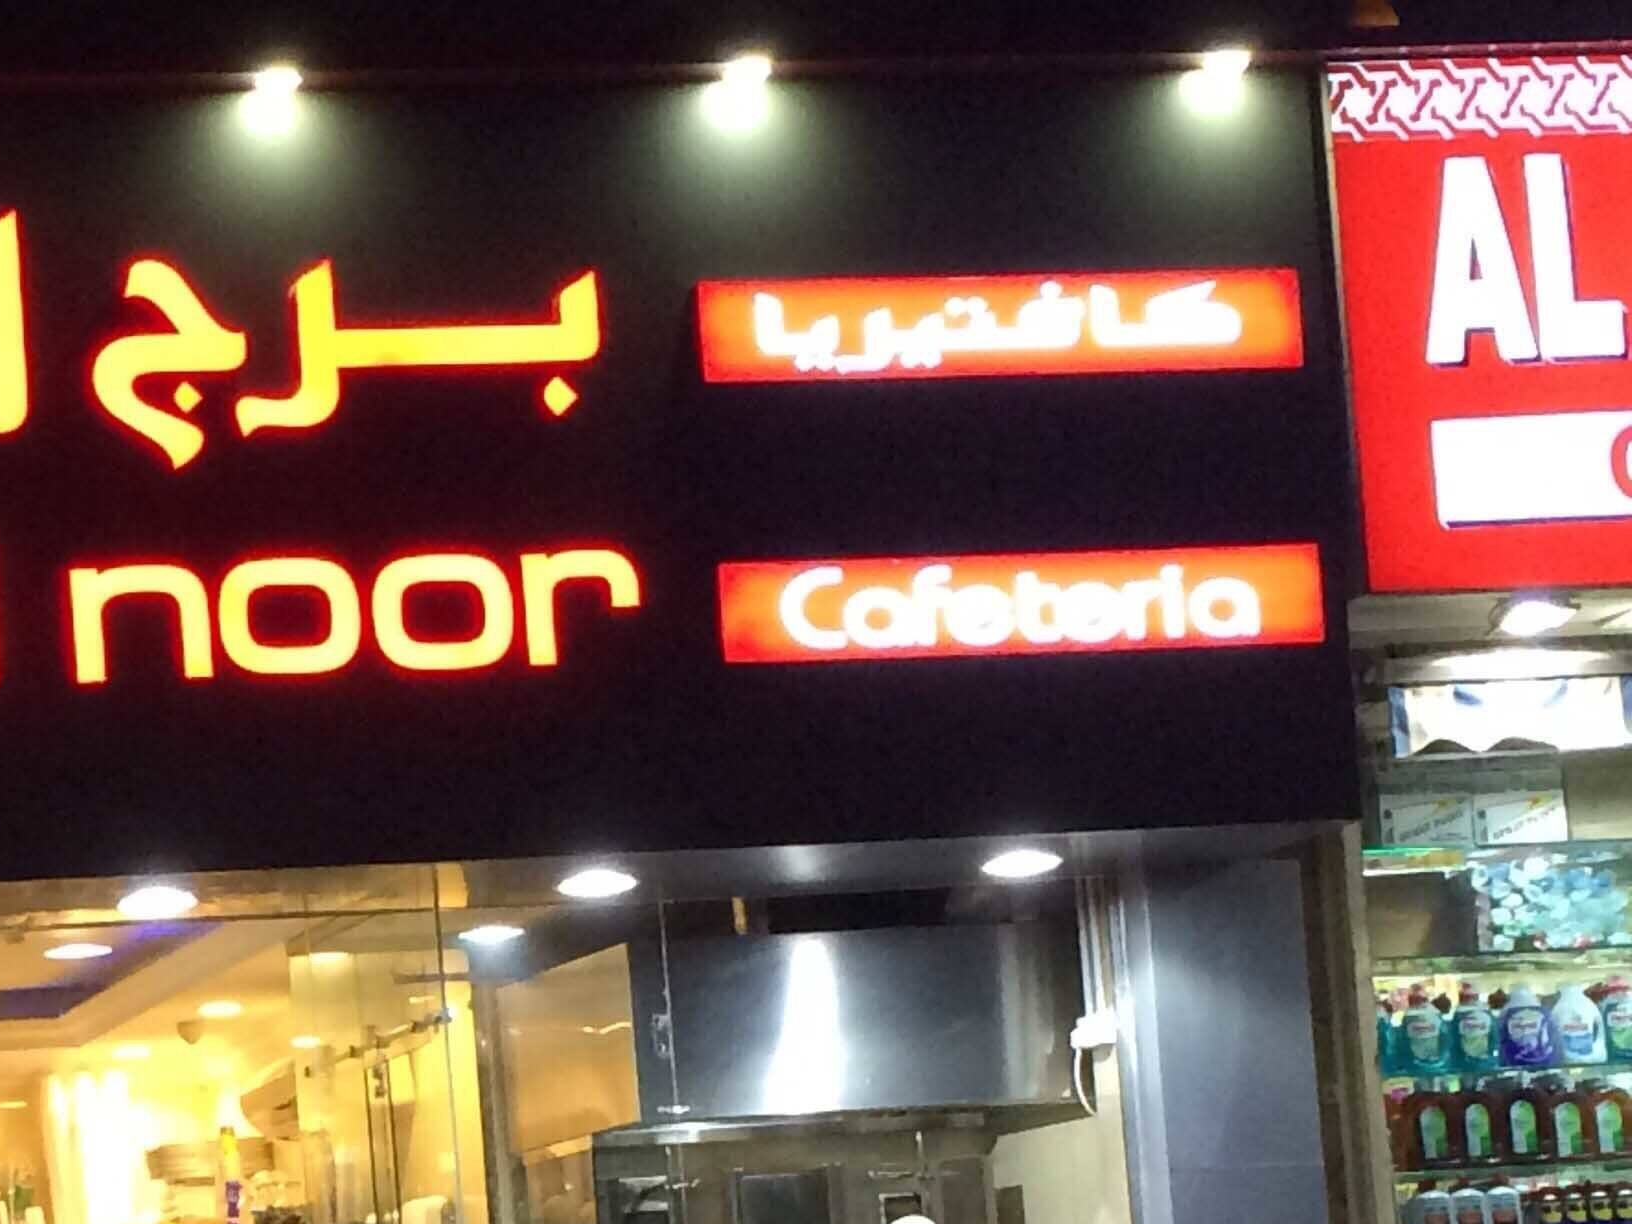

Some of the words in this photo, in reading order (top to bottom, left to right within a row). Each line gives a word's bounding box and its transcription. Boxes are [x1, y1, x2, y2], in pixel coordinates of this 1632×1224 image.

[1427, 153, 1626, 366] AL
[93, 260, 599, 468] برج
[752, 281, 1243, 373] كافتيريا
[70, 550, 639, 683] noor
[777, 564, 1262, 649] Cafeteria
